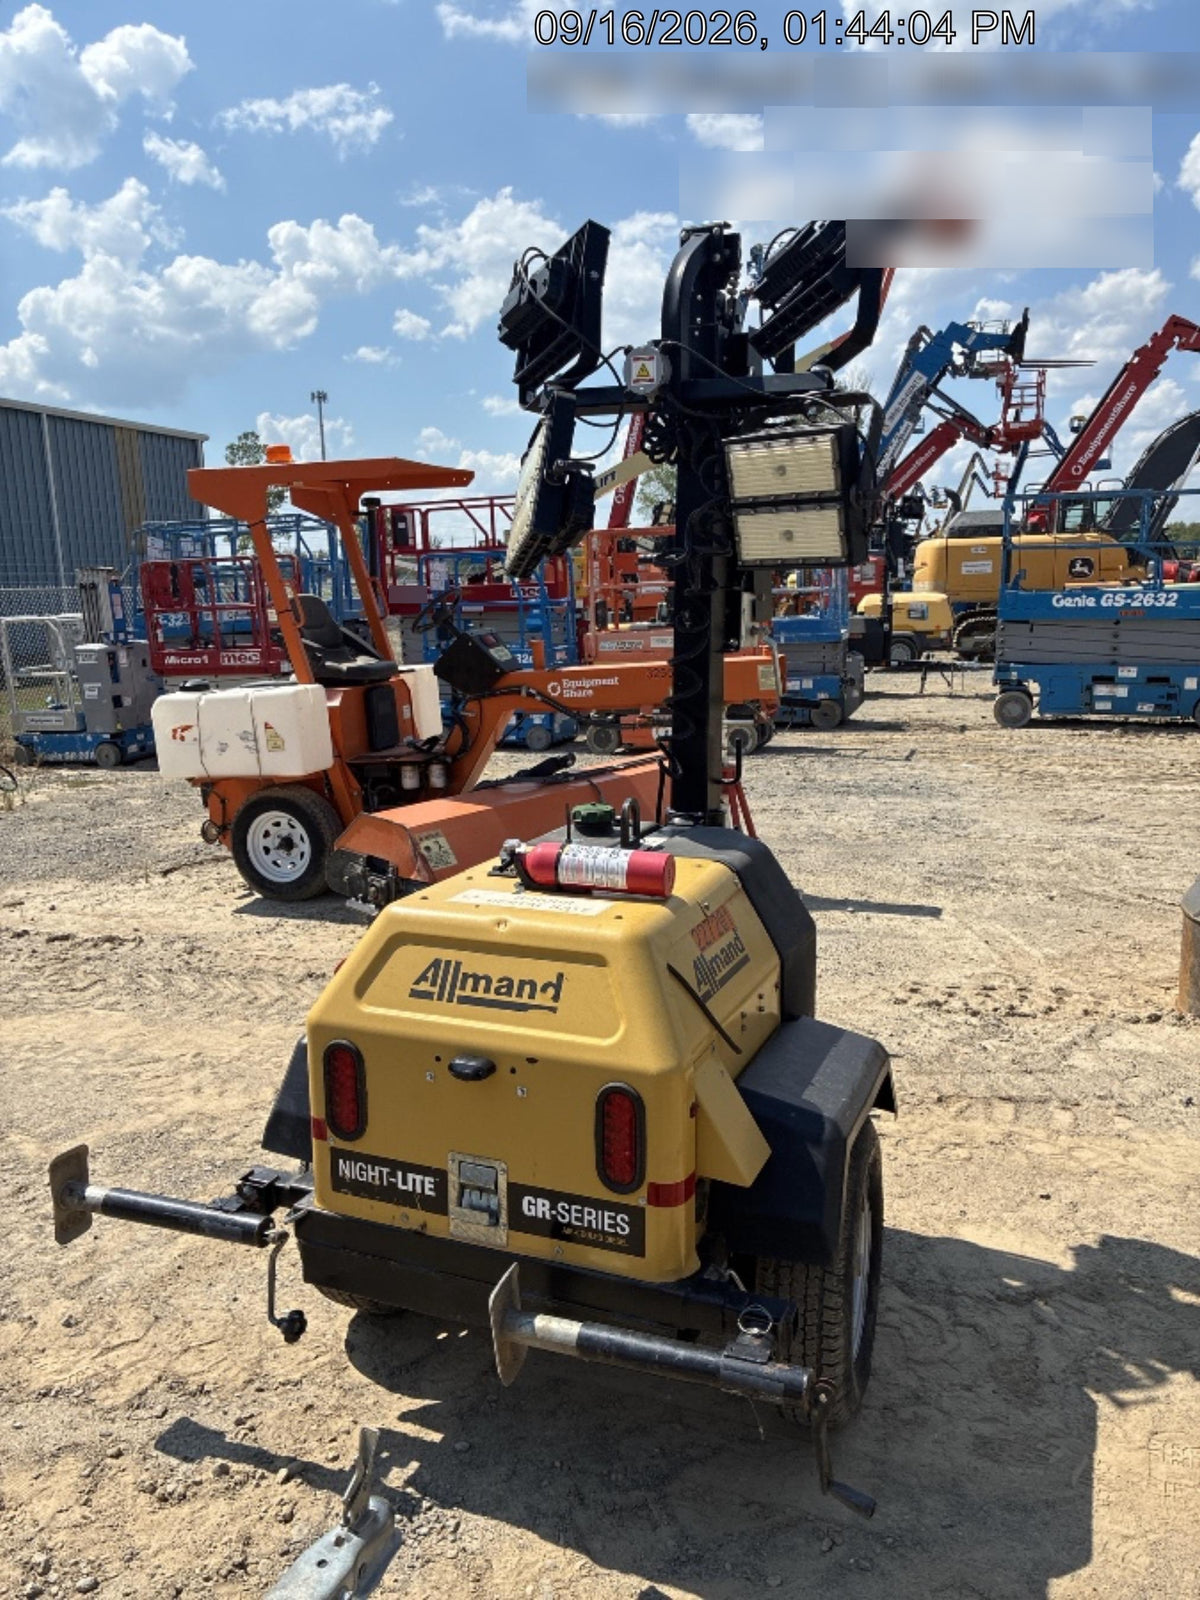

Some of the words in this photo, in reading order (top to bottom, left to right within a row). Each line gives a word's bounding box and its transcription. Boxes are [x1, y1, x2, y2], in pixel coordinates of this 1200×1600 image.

[1078, 384, 1137, 466] EquipmentShare
[1052, 594, 1097, 607] Genie
[1100, 592, 1179, 607] GS-2632
[221, 652, 260, 665] mec
[562, 676, 619, 689] Equipment
[562, 688, 593, 698] Share
[693, 927, 747, 996] Allmand
[411, 958, 565, 1006] Allmand
[338, 1158, 437, 1197] NIGHT-LITE
[522, 1195, 631, 1235] GR-SERIES
